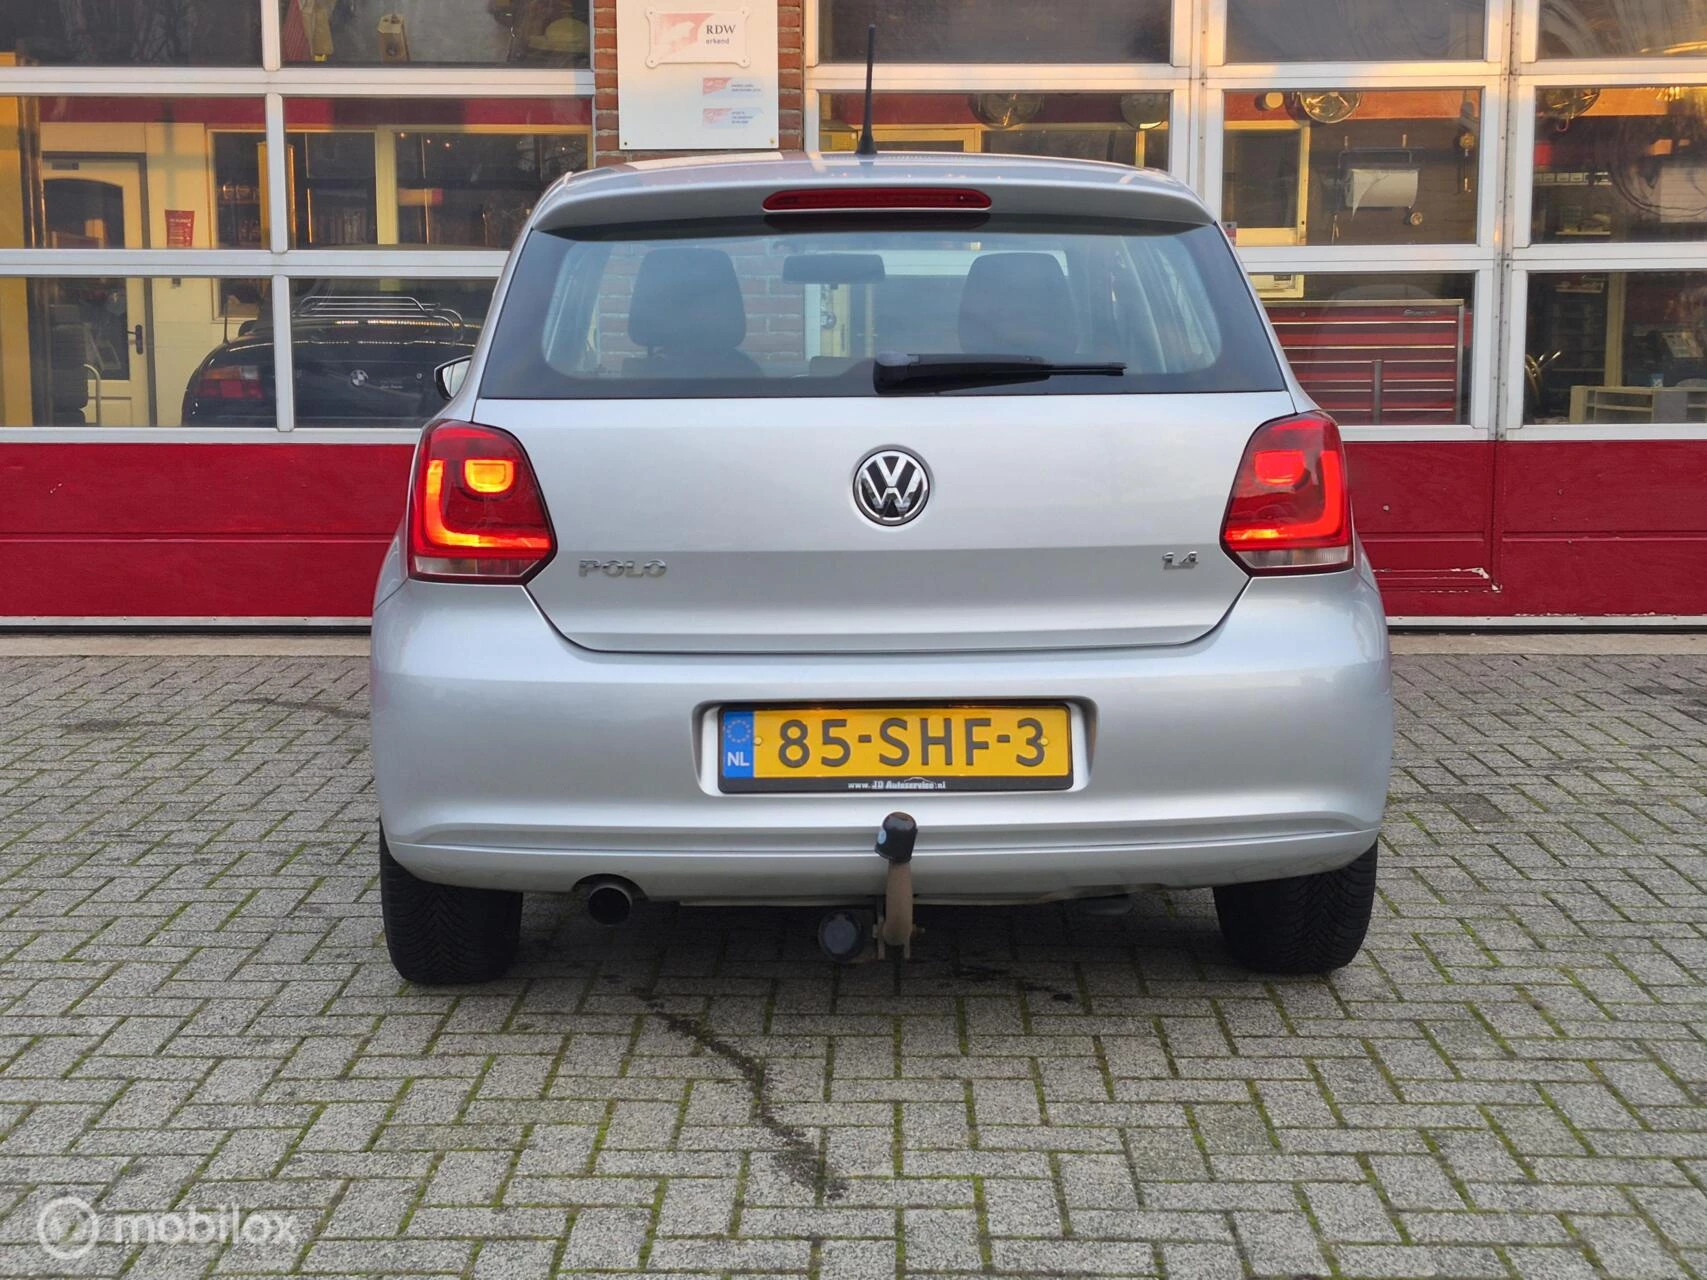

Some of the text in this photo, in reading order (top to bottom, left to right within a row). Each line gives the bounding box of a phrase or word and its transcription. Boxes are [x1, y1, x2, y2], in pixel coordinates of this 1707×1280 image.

[706, 24, 736, 35] RDW
[579, 559, 667, 578] POLO
[777, 717, 1046, 768] 85-SHF-3
[727, 752, 750, 767] NL
